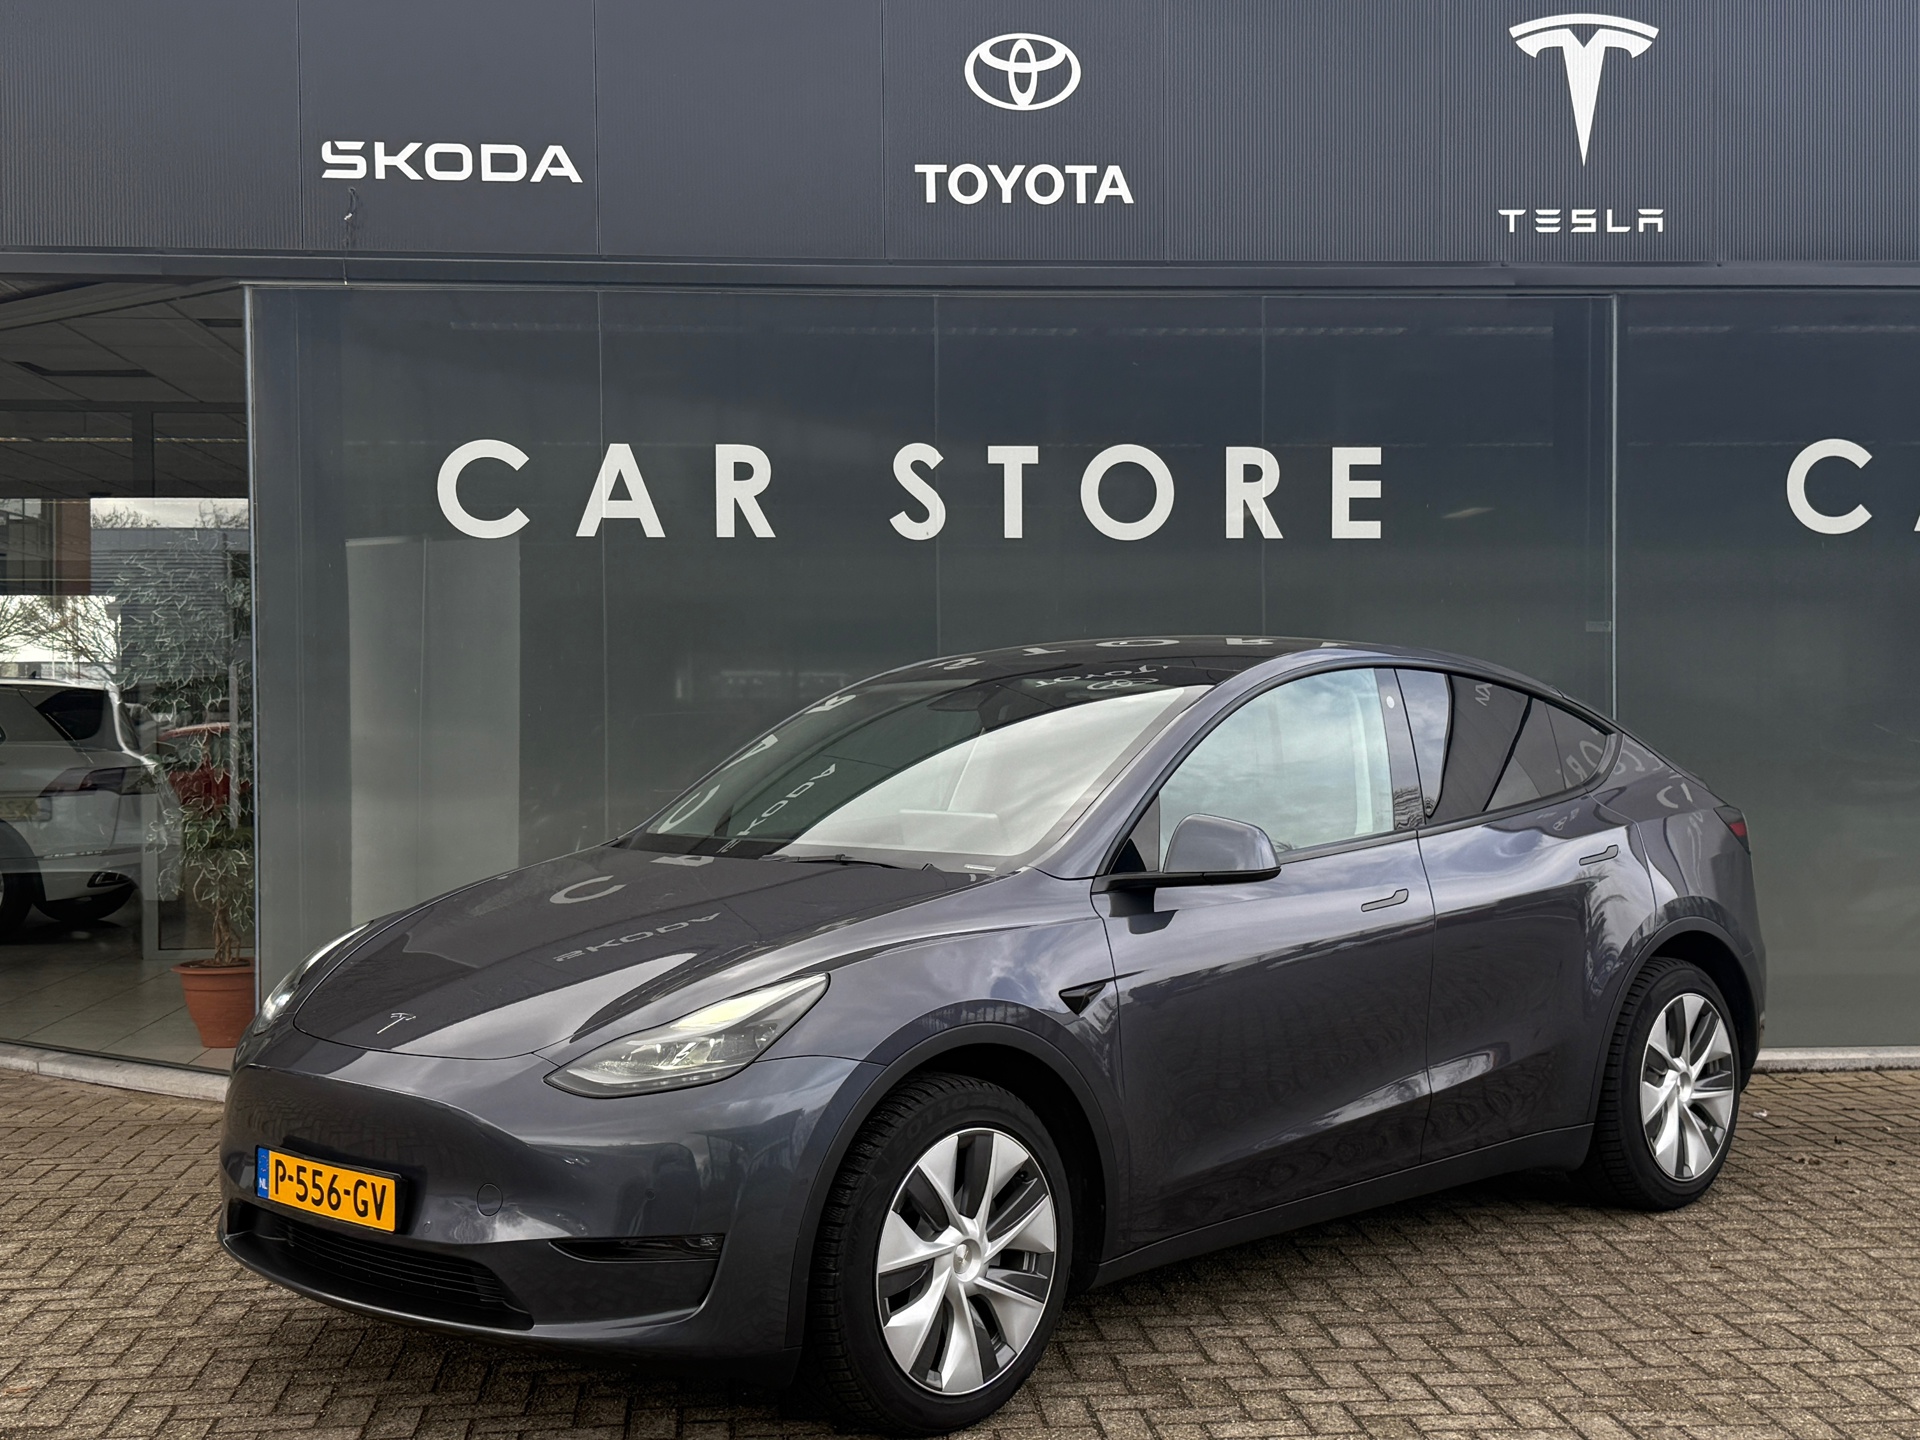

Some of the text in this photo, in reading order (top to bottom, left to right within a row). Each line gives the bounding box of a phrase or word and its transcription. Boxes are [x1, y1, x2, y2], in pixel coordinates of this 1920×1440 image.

[321, 140, 583, 184] SKODA
[914, 163, 1135, 205] TOYOTA
[1498, 208, 1665, 233] TESLA
[436, 439, 1382, 541] CAR STORE
[1786, 438, 1920, 535] C
[258, 1158, 388, 1222] NL P-556-GV
